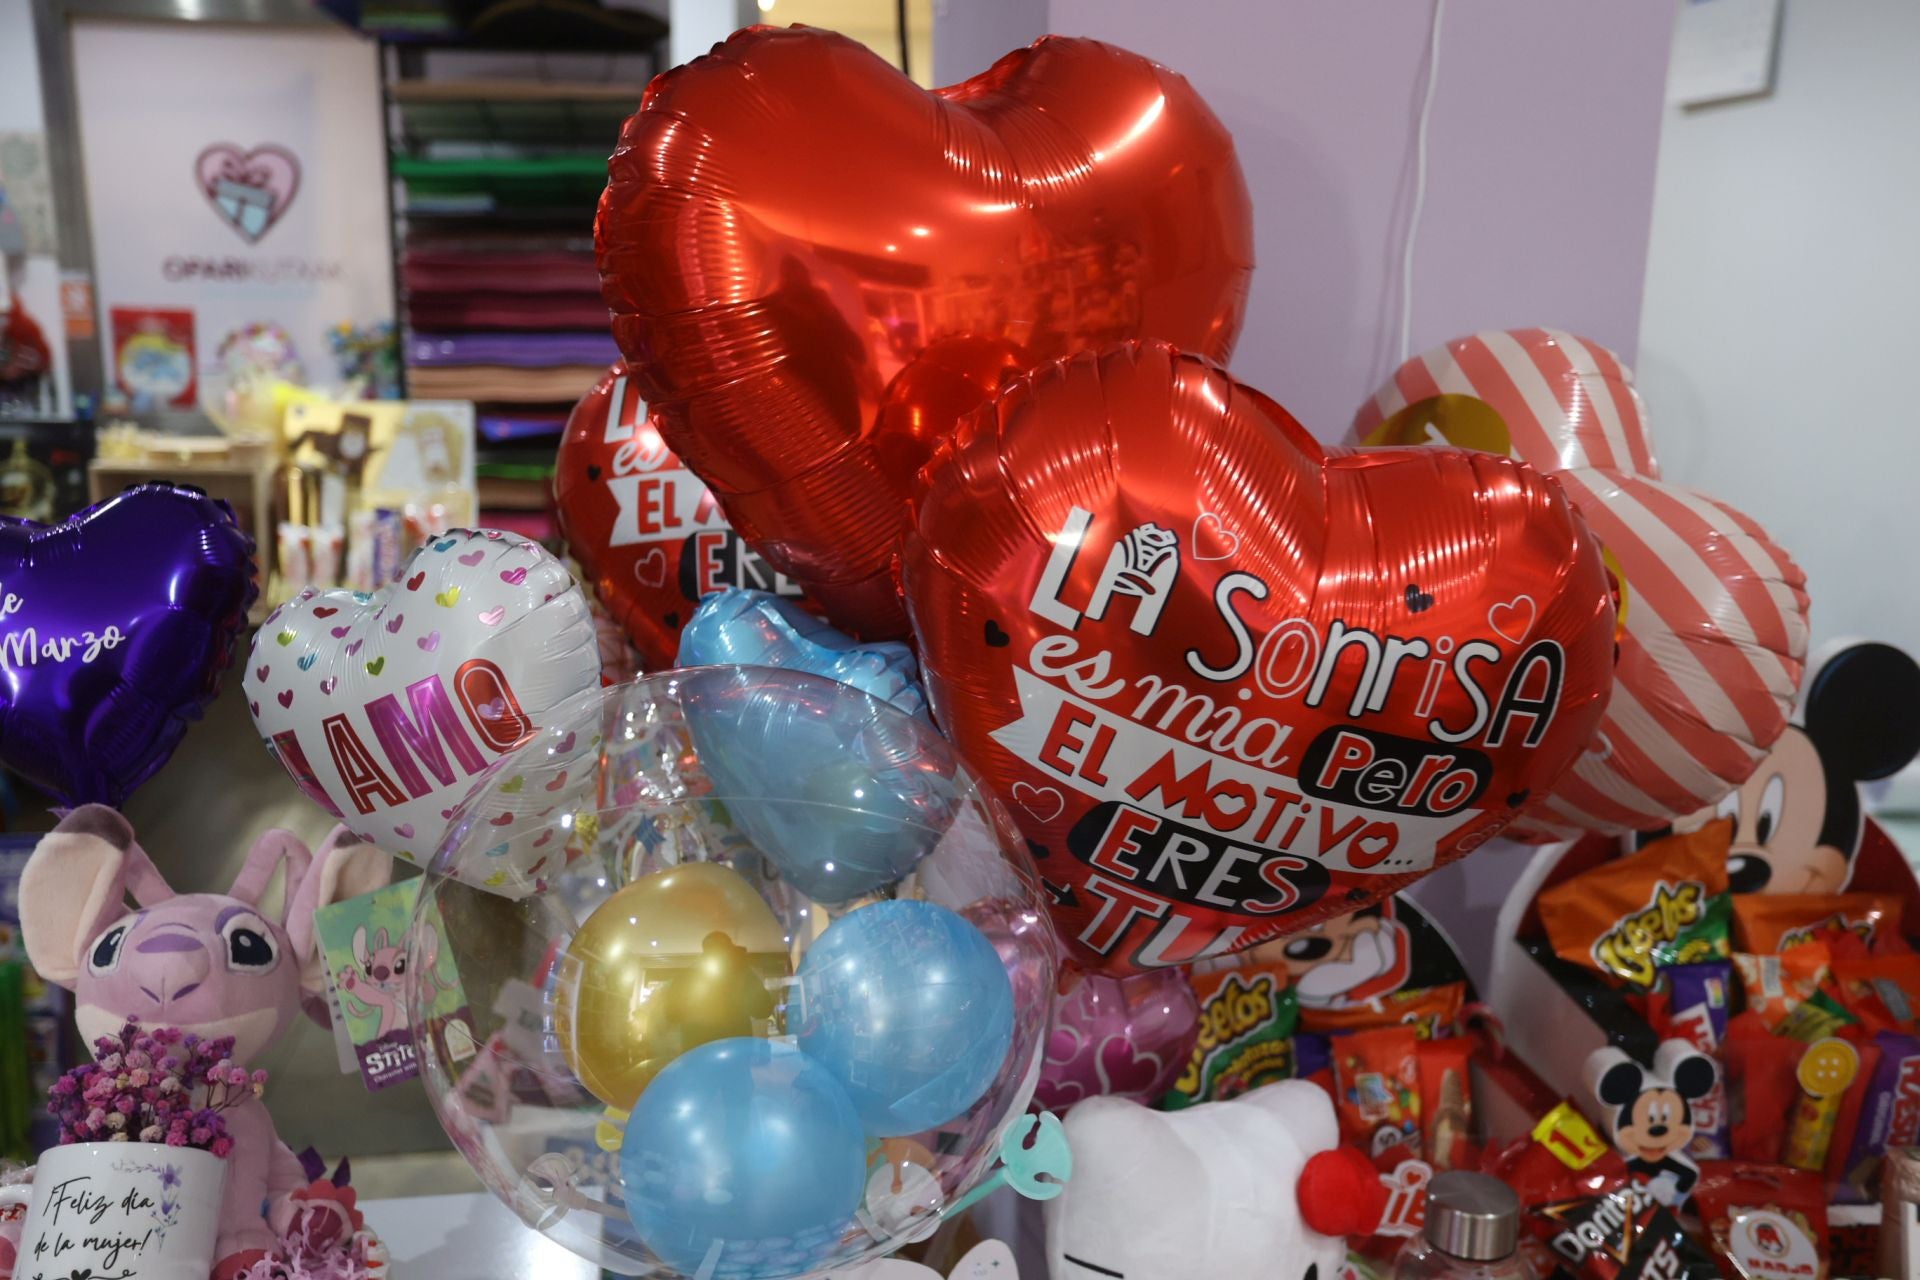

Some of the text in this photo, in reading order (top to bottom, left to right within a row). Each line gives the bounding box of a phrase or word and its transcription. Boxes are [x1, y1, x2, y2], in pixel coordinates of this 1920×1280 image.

[637, 479, 682, 535] EL
[1028, 505, 1180, 637] LA
[0, 625, 126, 668] Marzo
[1029, 635, 1126, 699] es
[1316, 730, 1478, 813] Pero
[1038, 700, 1117, 788] EL
[1089, 802, 1309, 914] ERES
[34, 1231, 50, 1261] de
[54, 1232, 75, 1257] la
